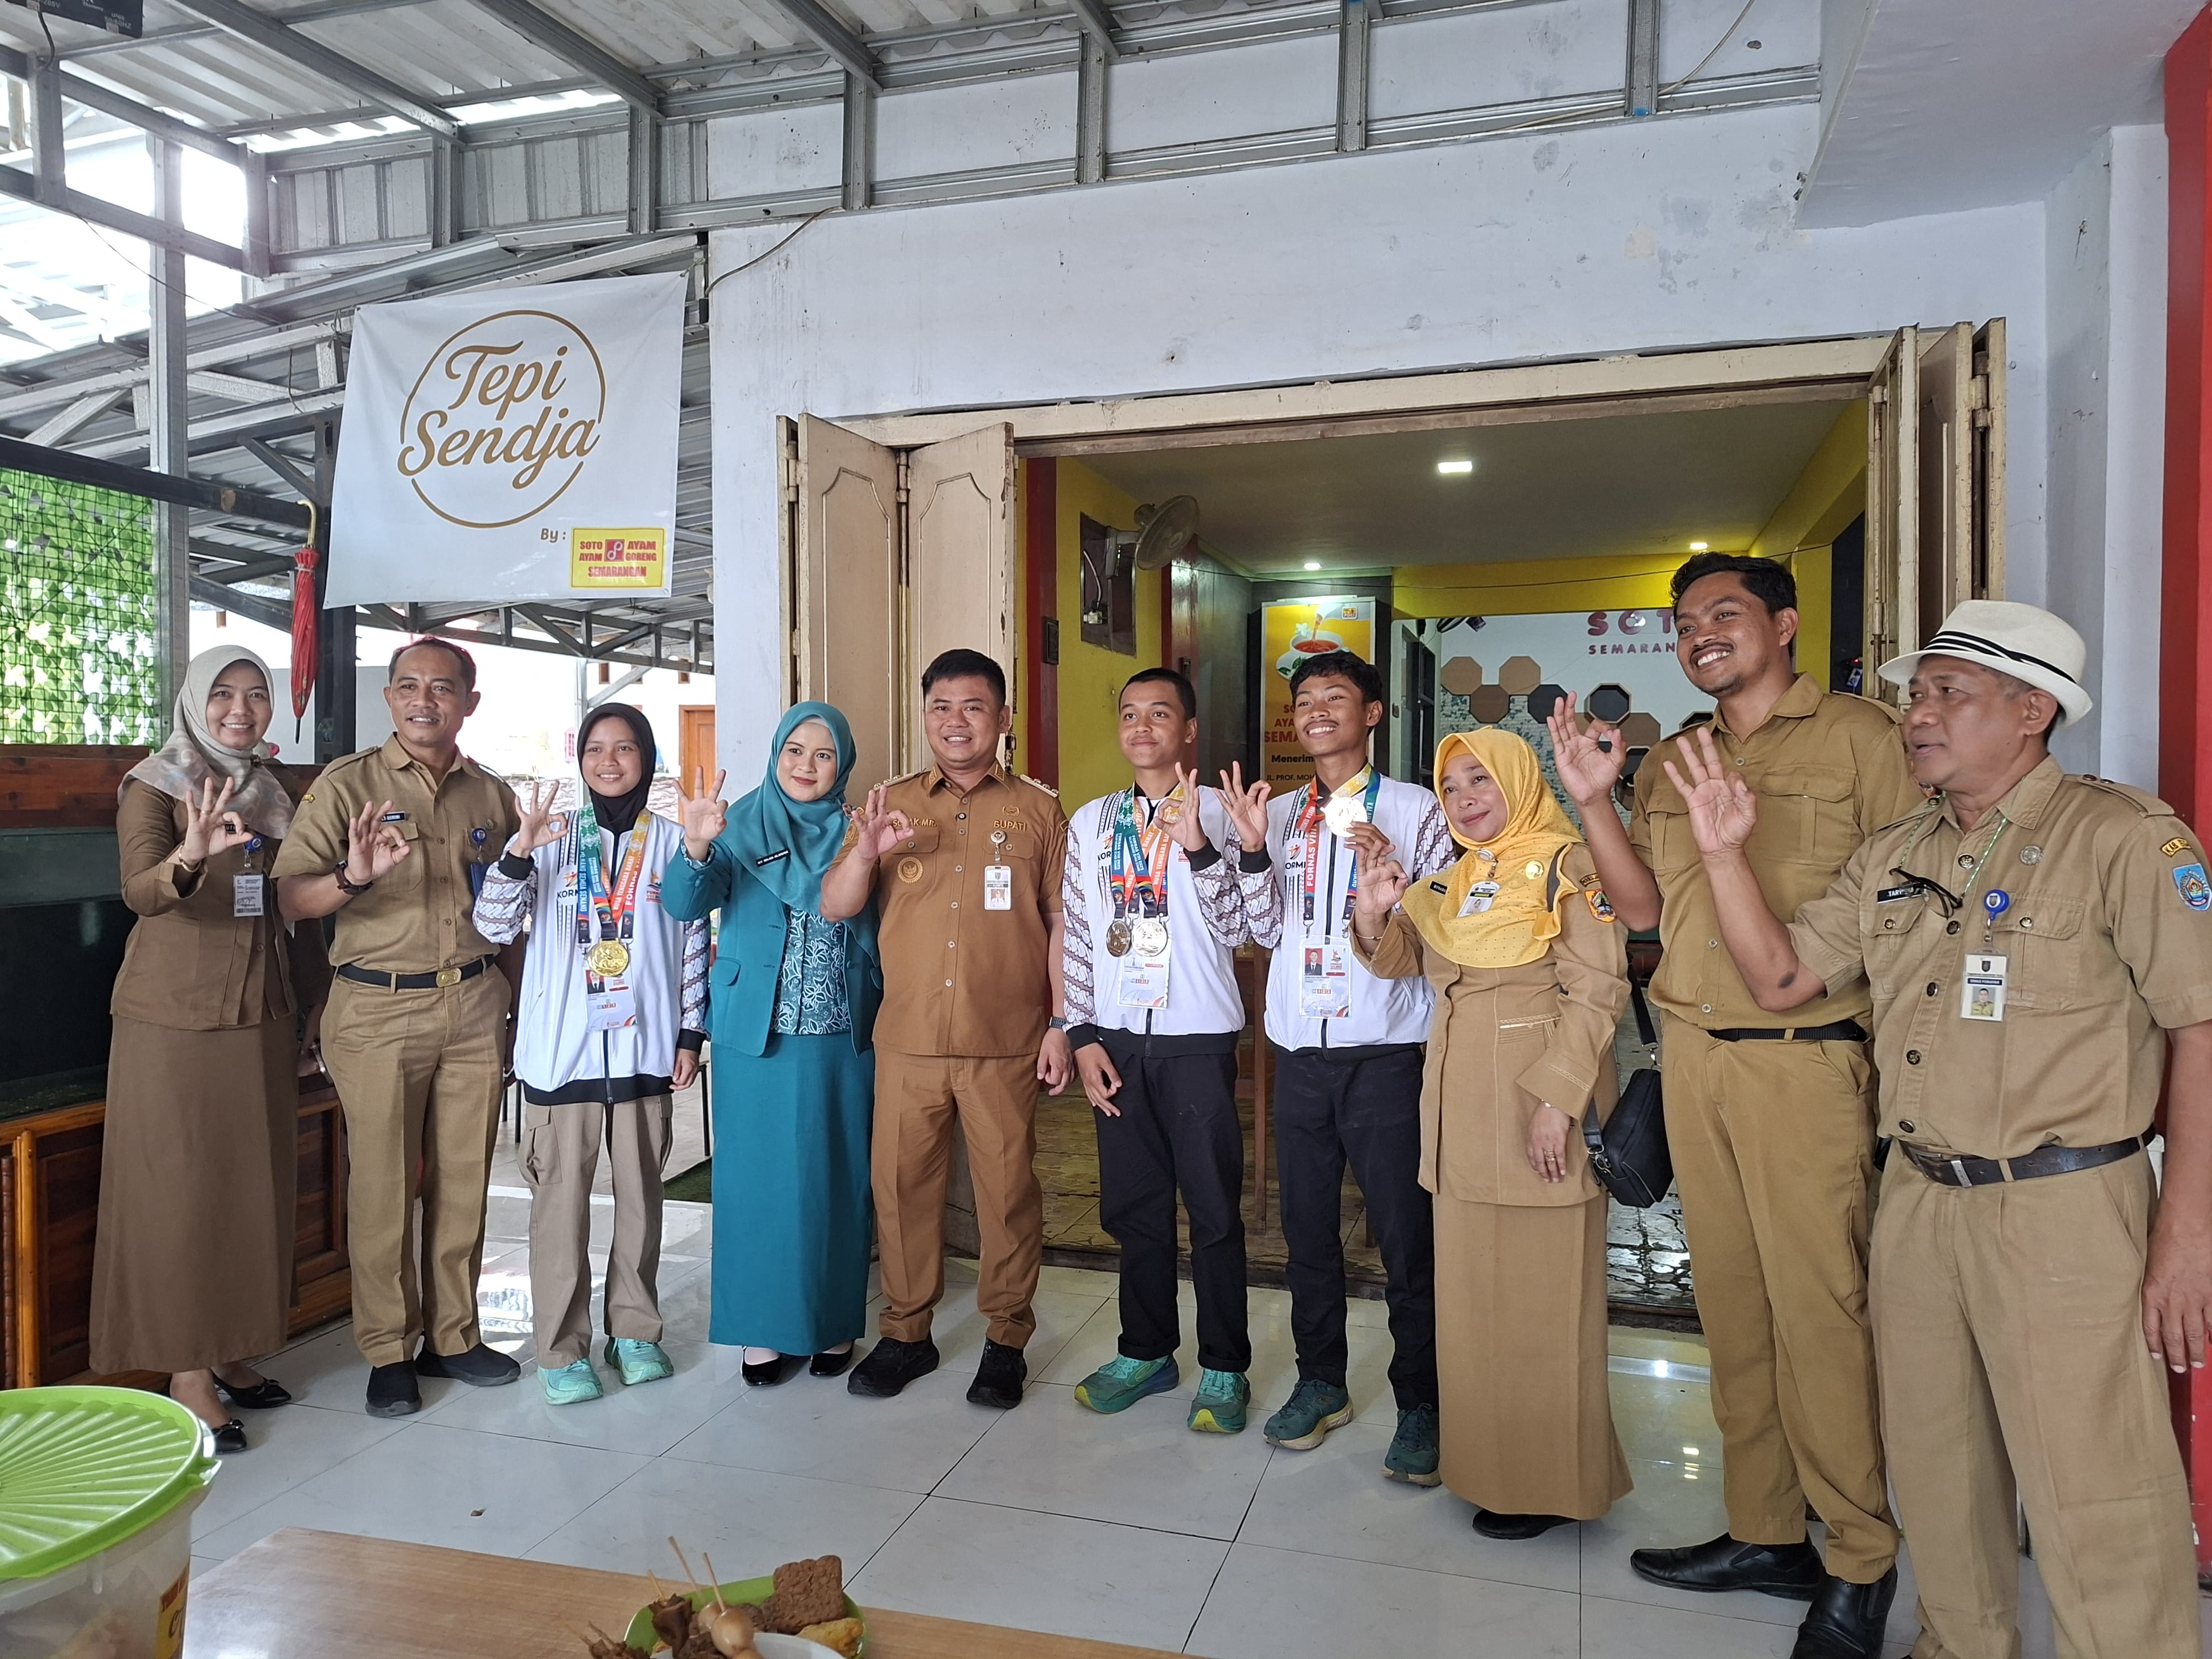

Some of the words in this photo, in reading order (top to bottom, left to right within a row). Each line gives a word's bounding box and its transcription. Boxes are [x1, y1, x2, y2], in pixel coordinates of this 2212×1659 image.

[445, 341, 567, 420] Tepi
[398, 406, 599, 489] Sendja
[540, 528, 559, 542] By
[580, 541, 603, 550] SOTO
[627, 541, 656, 550] AYAM
[579, 553, 602, 561] AYAM
[625, 553, 657, 561] GORENG
[588, 566, 646, 577] SEMARANGAN
[1588, 609, 1675, 636] SOT
[1588, 642, 1676, 655] SEMARAN
[1284, 705, 1295, 713] SO
[1274, 718, 1295, 727] AYA
[1265, 731, 1299, 743] SEMA
[1271, 754, 1314, 763] Menerim
[994, 820, 1027, 832] BUPATI
[1156, 843, 1167, 869] TENGGARA
[1285, 861, 1306, 870] ORMI
[1307, 847, 1316, 886] FORNAS
